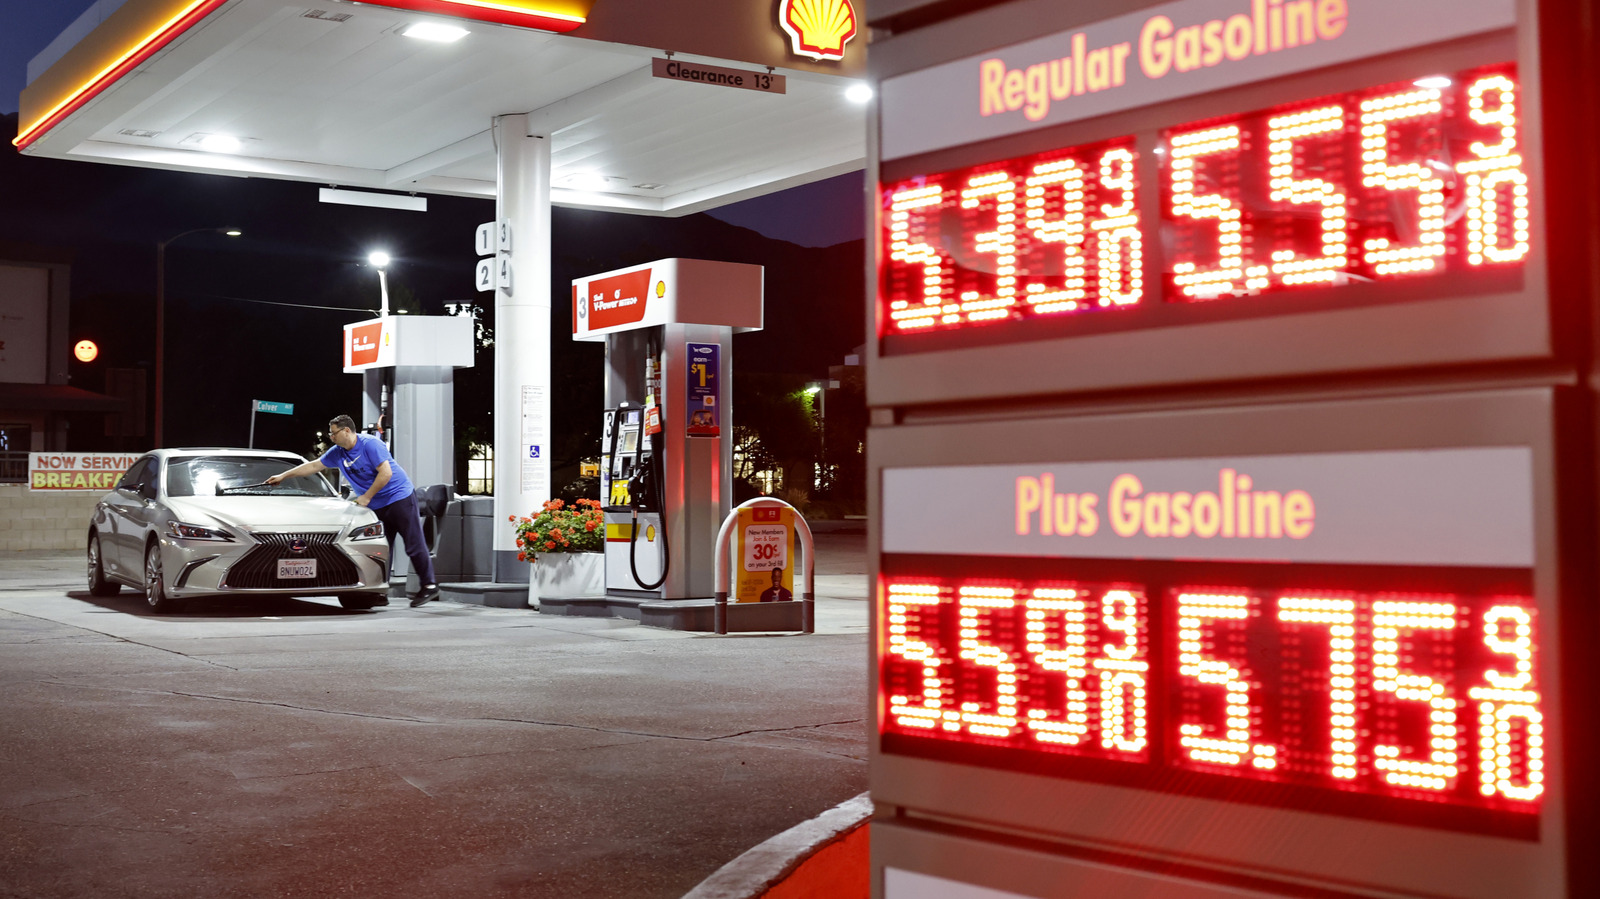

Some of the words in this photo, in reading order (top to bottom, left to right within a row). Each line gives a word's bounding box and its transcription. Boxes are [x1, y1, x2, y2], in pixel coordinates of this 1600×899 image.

[979, 34, 1130, 121] Regular
[1139, 0, 1348, 80] Gasoline
[666, 62, 743, 86] Clearance
[754, 74, 774, 90] 13'
[1170, 87, 1446, 297] 5.55
[482, 229, 487, 250] 1
[501, 223, 507, 243] 3
[890, 157, 1086, 330] 5.39
[481, 265, 489, 286] 2
[501, 259, 507, 280] 4
[579, 297, 587, 319] 3
[691, 363, 706, 387] $1
[257, 401, 278, 412] Culver
[606, 412, 613, 438] 3
[37, 456, 76, 469] NOW
[81, 456, 139, 470] SERVIN
[33, 472, 121, 488] BREAKFA
[1016, 473, 1100, 538] Plus
[1108, 469, 1315, 539] Gasoline
[888, 583, 1088, 745] 5.59
[1177, 592, 1458, 790] 5.75
